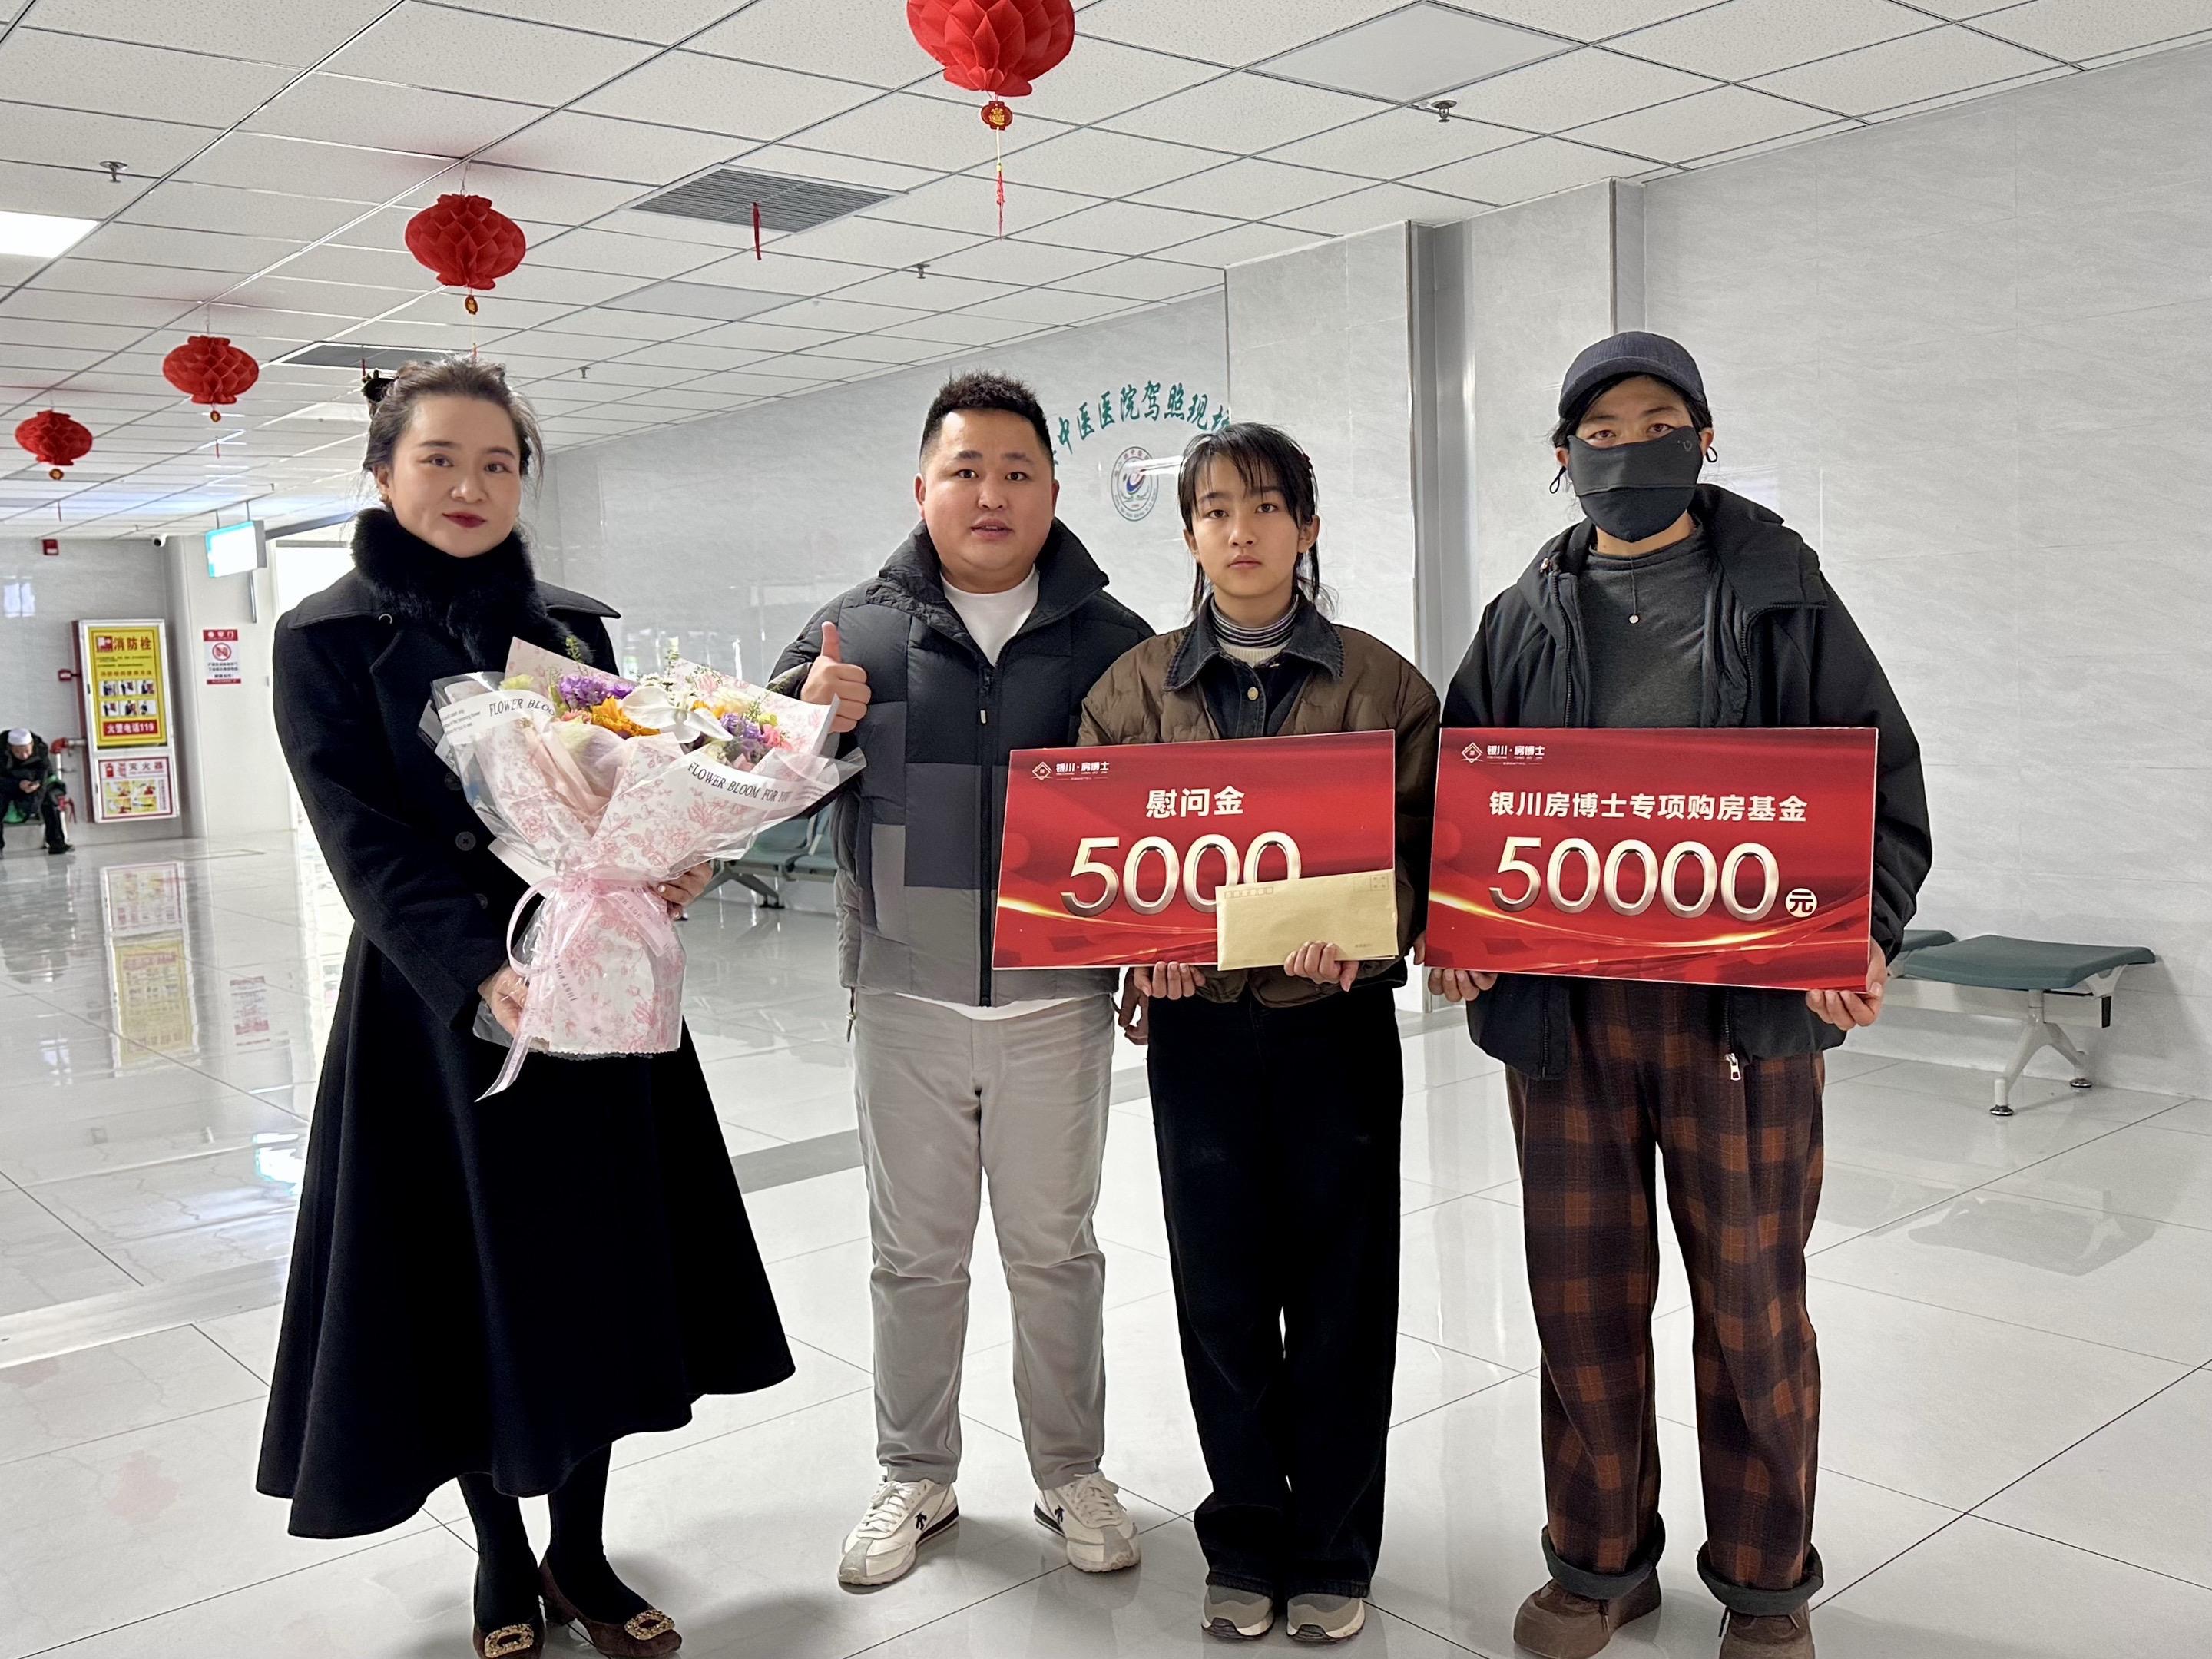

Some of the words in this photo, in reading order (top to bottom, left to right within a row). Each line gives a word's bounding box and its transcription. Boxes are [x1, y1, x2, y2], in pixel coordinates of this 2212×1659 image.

[1053, 380, 1230, 465] 中医医院驾照现
[114, 636, 151, 651] 消防栓
[489, 698, 524, 717] FLOWER
[688, 762, 727, 789] FLOWER
[727, 780, 760, 800] BLOOM
[1145, 785, 1246, 819] 慰问金
[1488, 790, 1808, 823] 银川房博士专项购房基金
[1060, 831, 1302, 917] 5000
